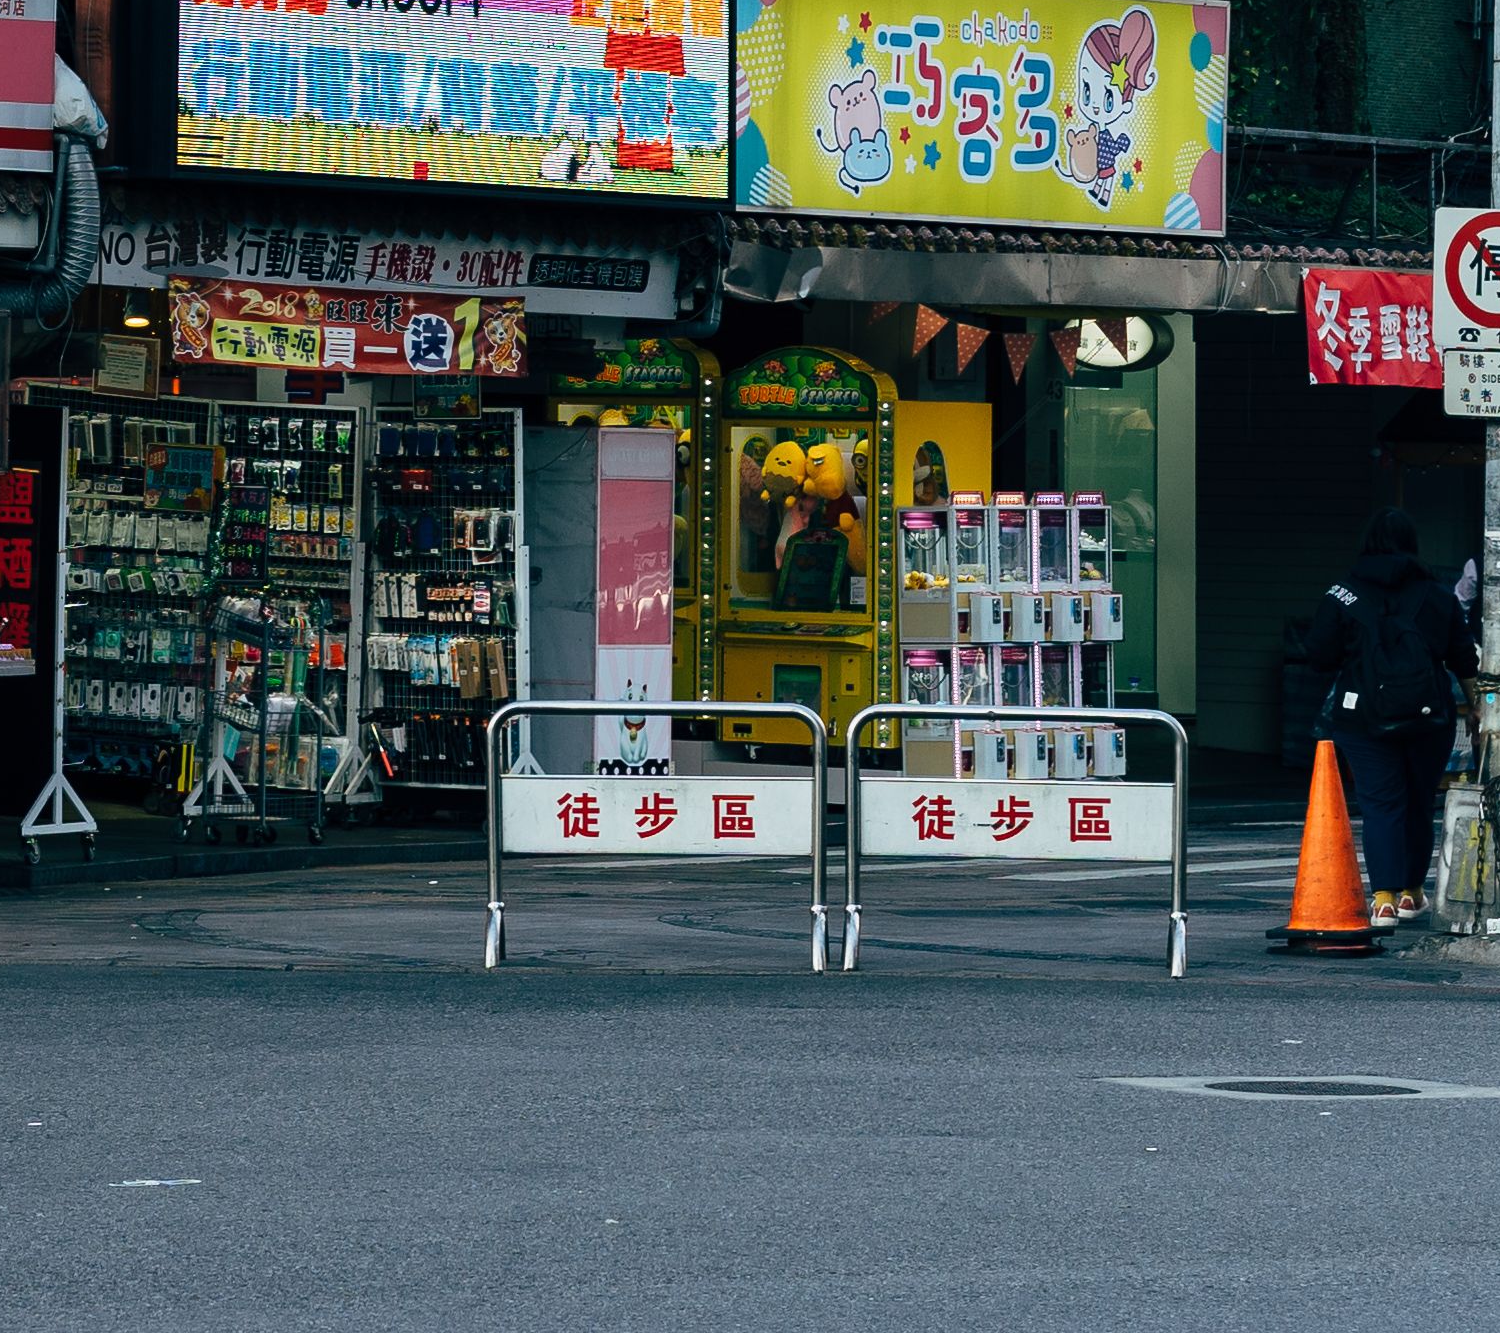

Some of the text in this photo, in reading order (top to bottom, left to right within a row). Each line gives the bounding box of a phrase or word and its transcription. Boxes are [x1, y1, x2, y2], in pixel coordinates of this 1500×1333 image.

[960, 9, 1039, 46] chakodo
[877, 21, 1057, 178] 巧客多
[144, 221, 645, 288] 台灣製 行動電源 手機殼 透明化全機包膜
[238, 288, 408, 332] 2018 旺旺來
[1314, 281, 1431, 373] 冬季雪鞋
[213, 323, 320, 361] 行動電源
[738, 385, 862, 409] TURTLE STACKER
[555, 790, 757, 839] 徒步區
[911, 793, 1113, 842] 徒步區
